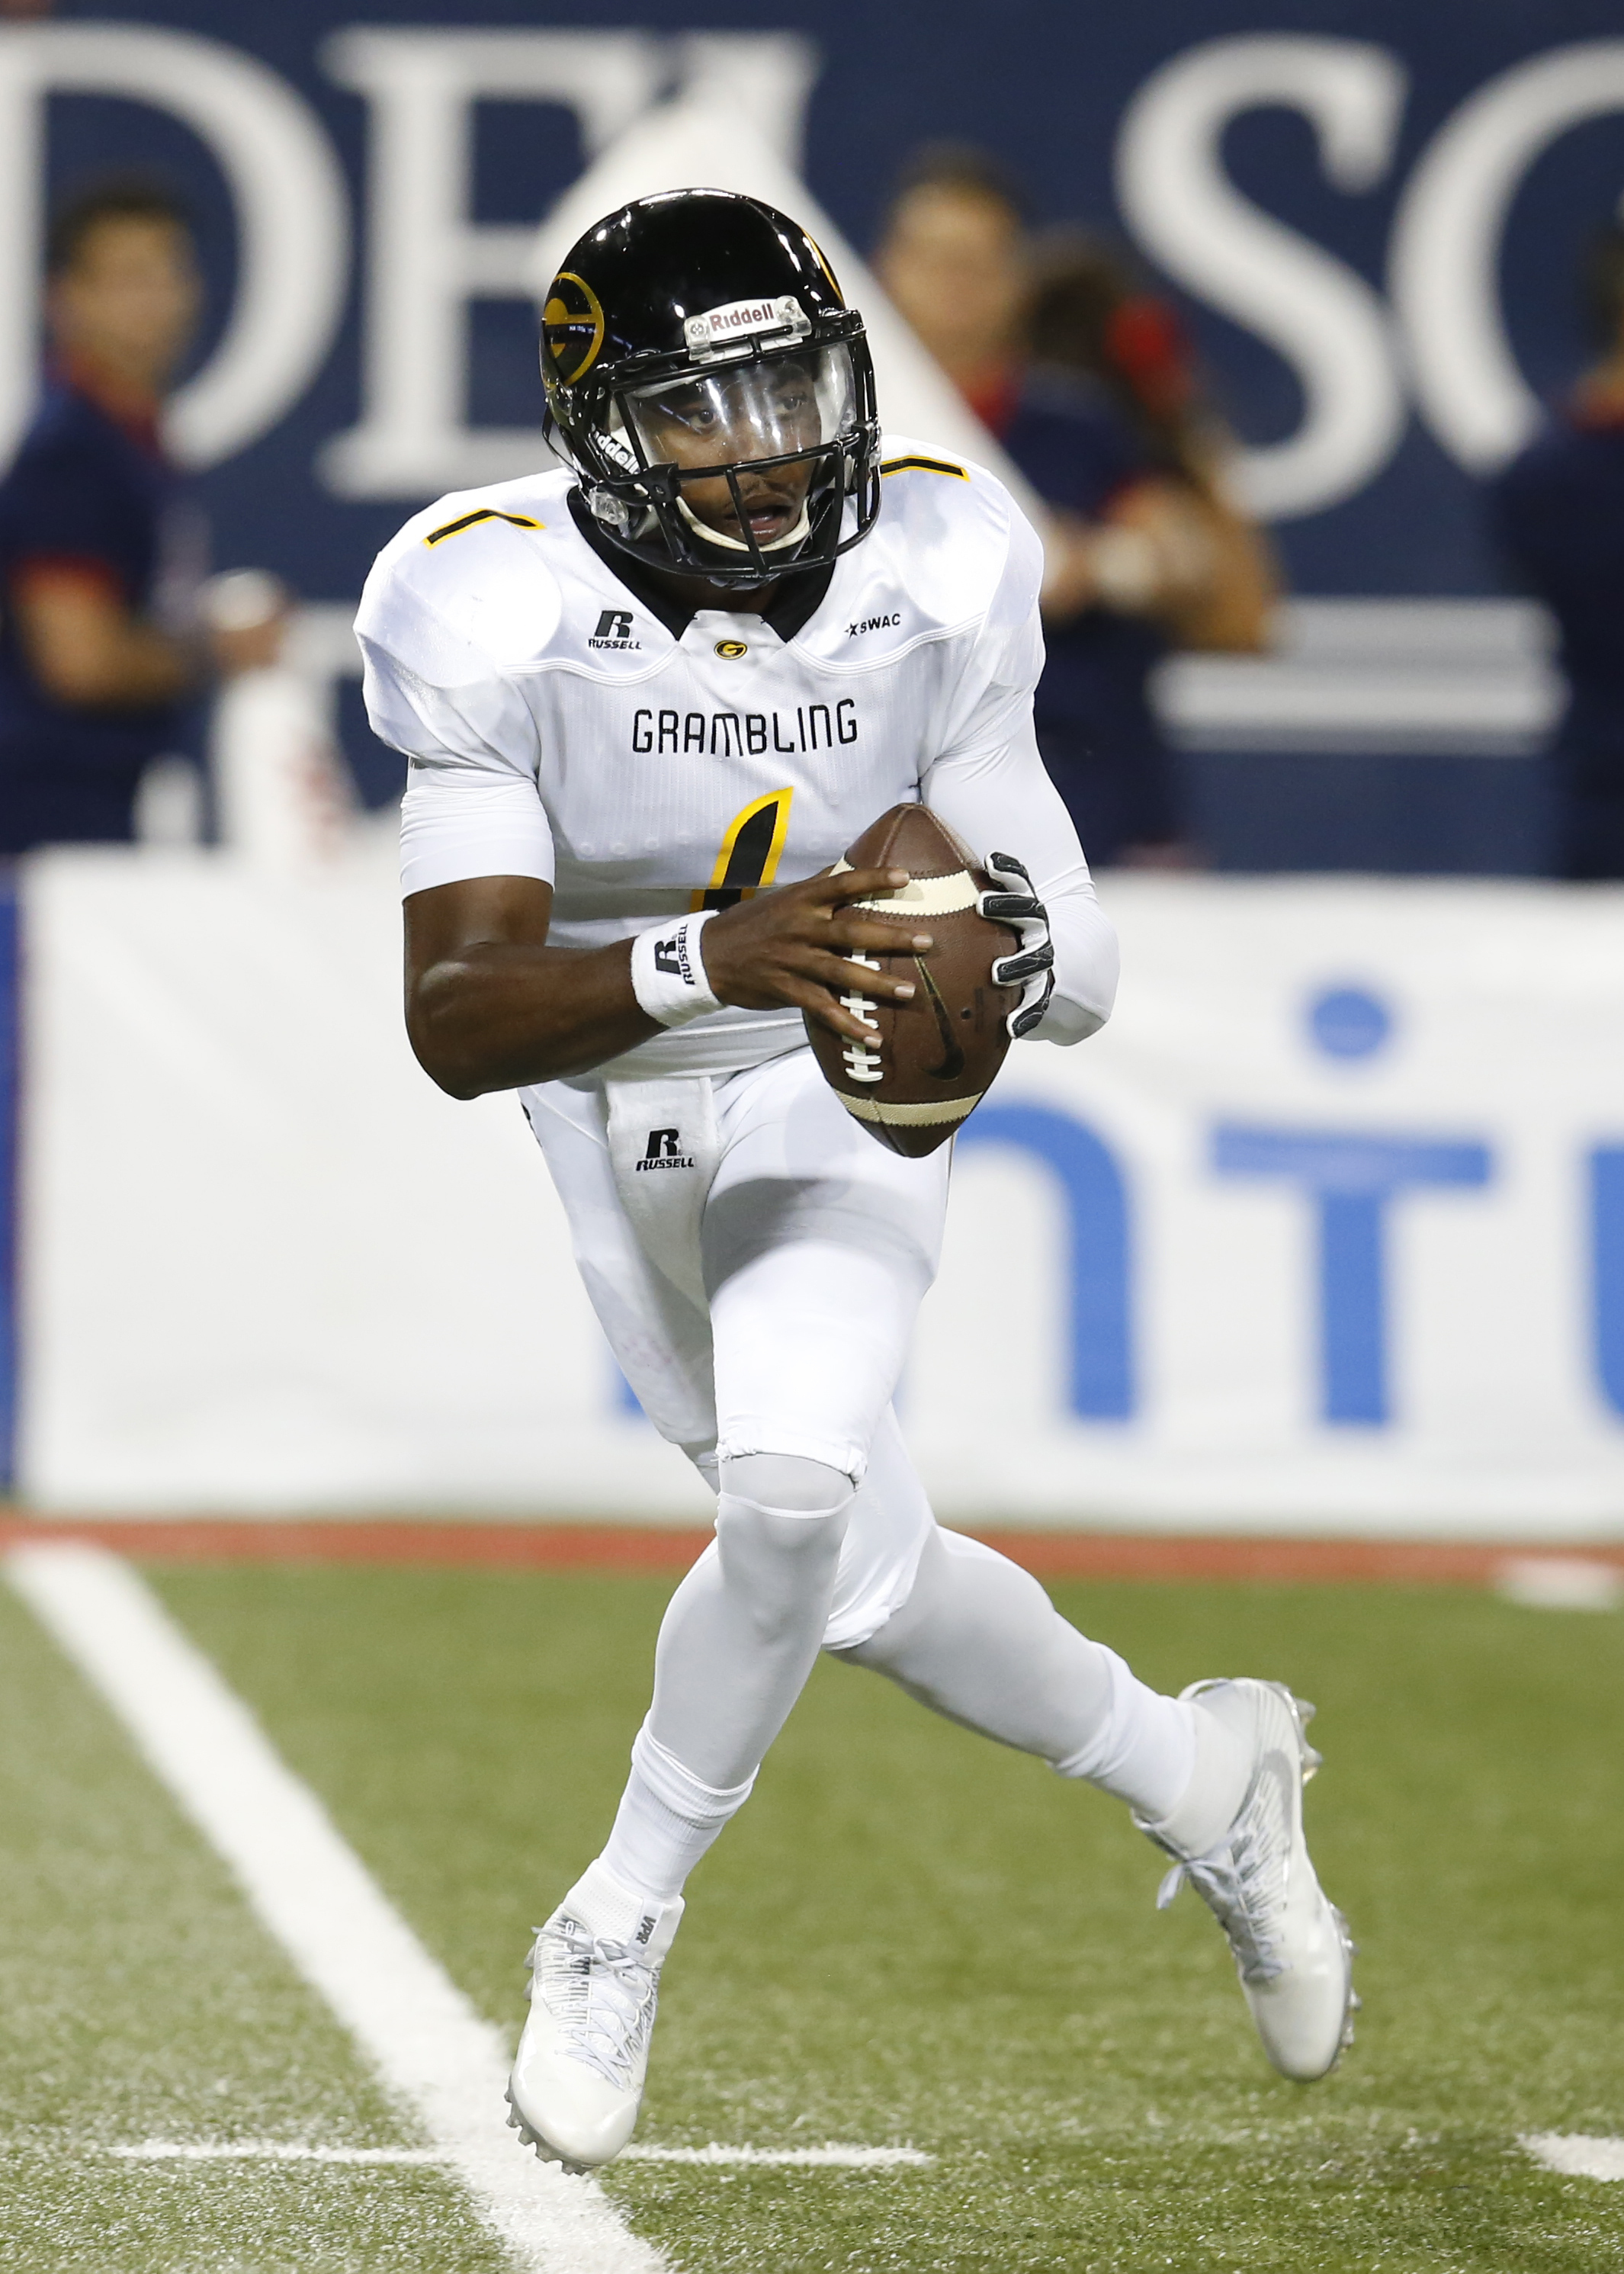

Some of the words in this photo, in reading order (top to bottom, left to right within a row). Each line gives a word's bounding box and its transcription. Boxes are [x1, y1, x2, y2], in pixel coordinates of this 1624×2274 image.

[709, 303, 775, 330] Riddell
[859, 612, 901, 634] SWAC
[589, 638, 642, 650] RUSSELL
[632, 699, 858, 757] GRAMBLING
[678, 923, 695, 985] RUSSELL
[635, 1158, 695, 1172] RUSSELL
